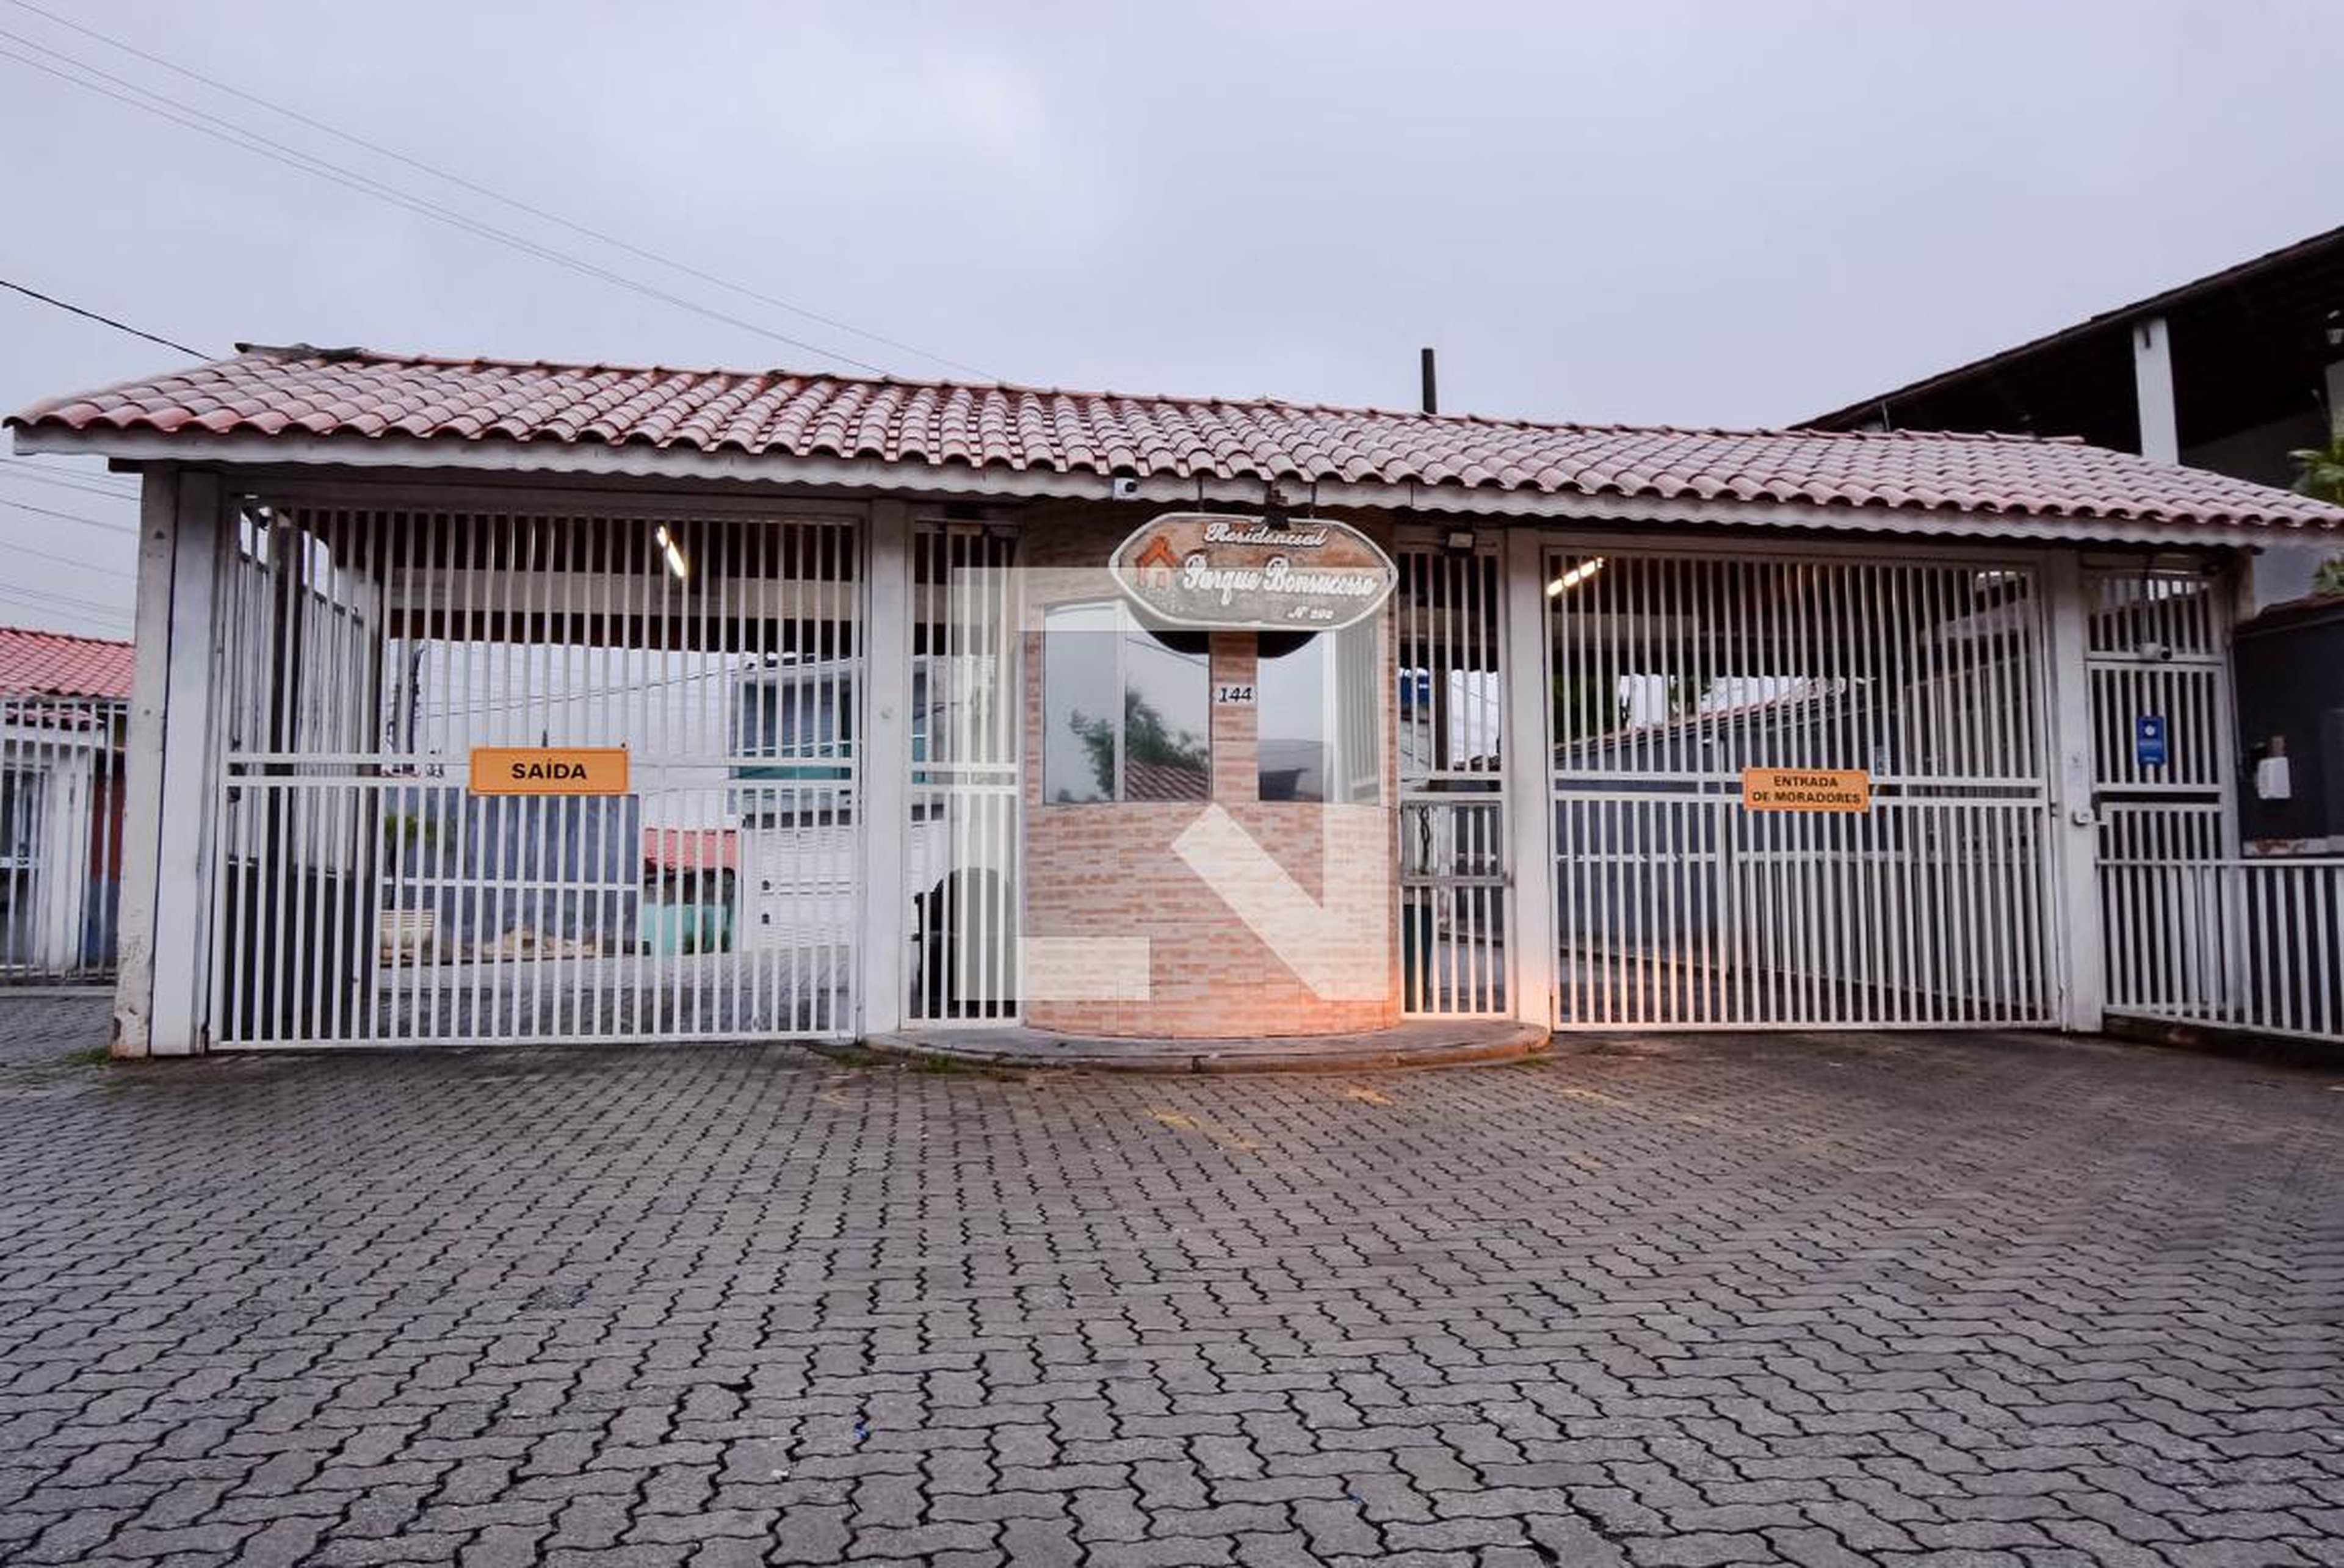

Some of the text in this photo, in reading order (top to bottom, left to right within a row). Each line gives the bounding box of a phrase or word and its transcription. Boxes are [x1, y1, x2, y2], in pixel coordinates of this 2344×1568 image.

[1204, 522, 1328, 546] Residencial
[1183, 554, 1377, 605] Parque Bonsucesso
[1219, 687, 1251, 703] 144
[511, 757, 587, 779] SAÍDA
[1773, 776, 1839, 787] ENTRADA
[1753, 792, 1861, 804] DE MORADORES
